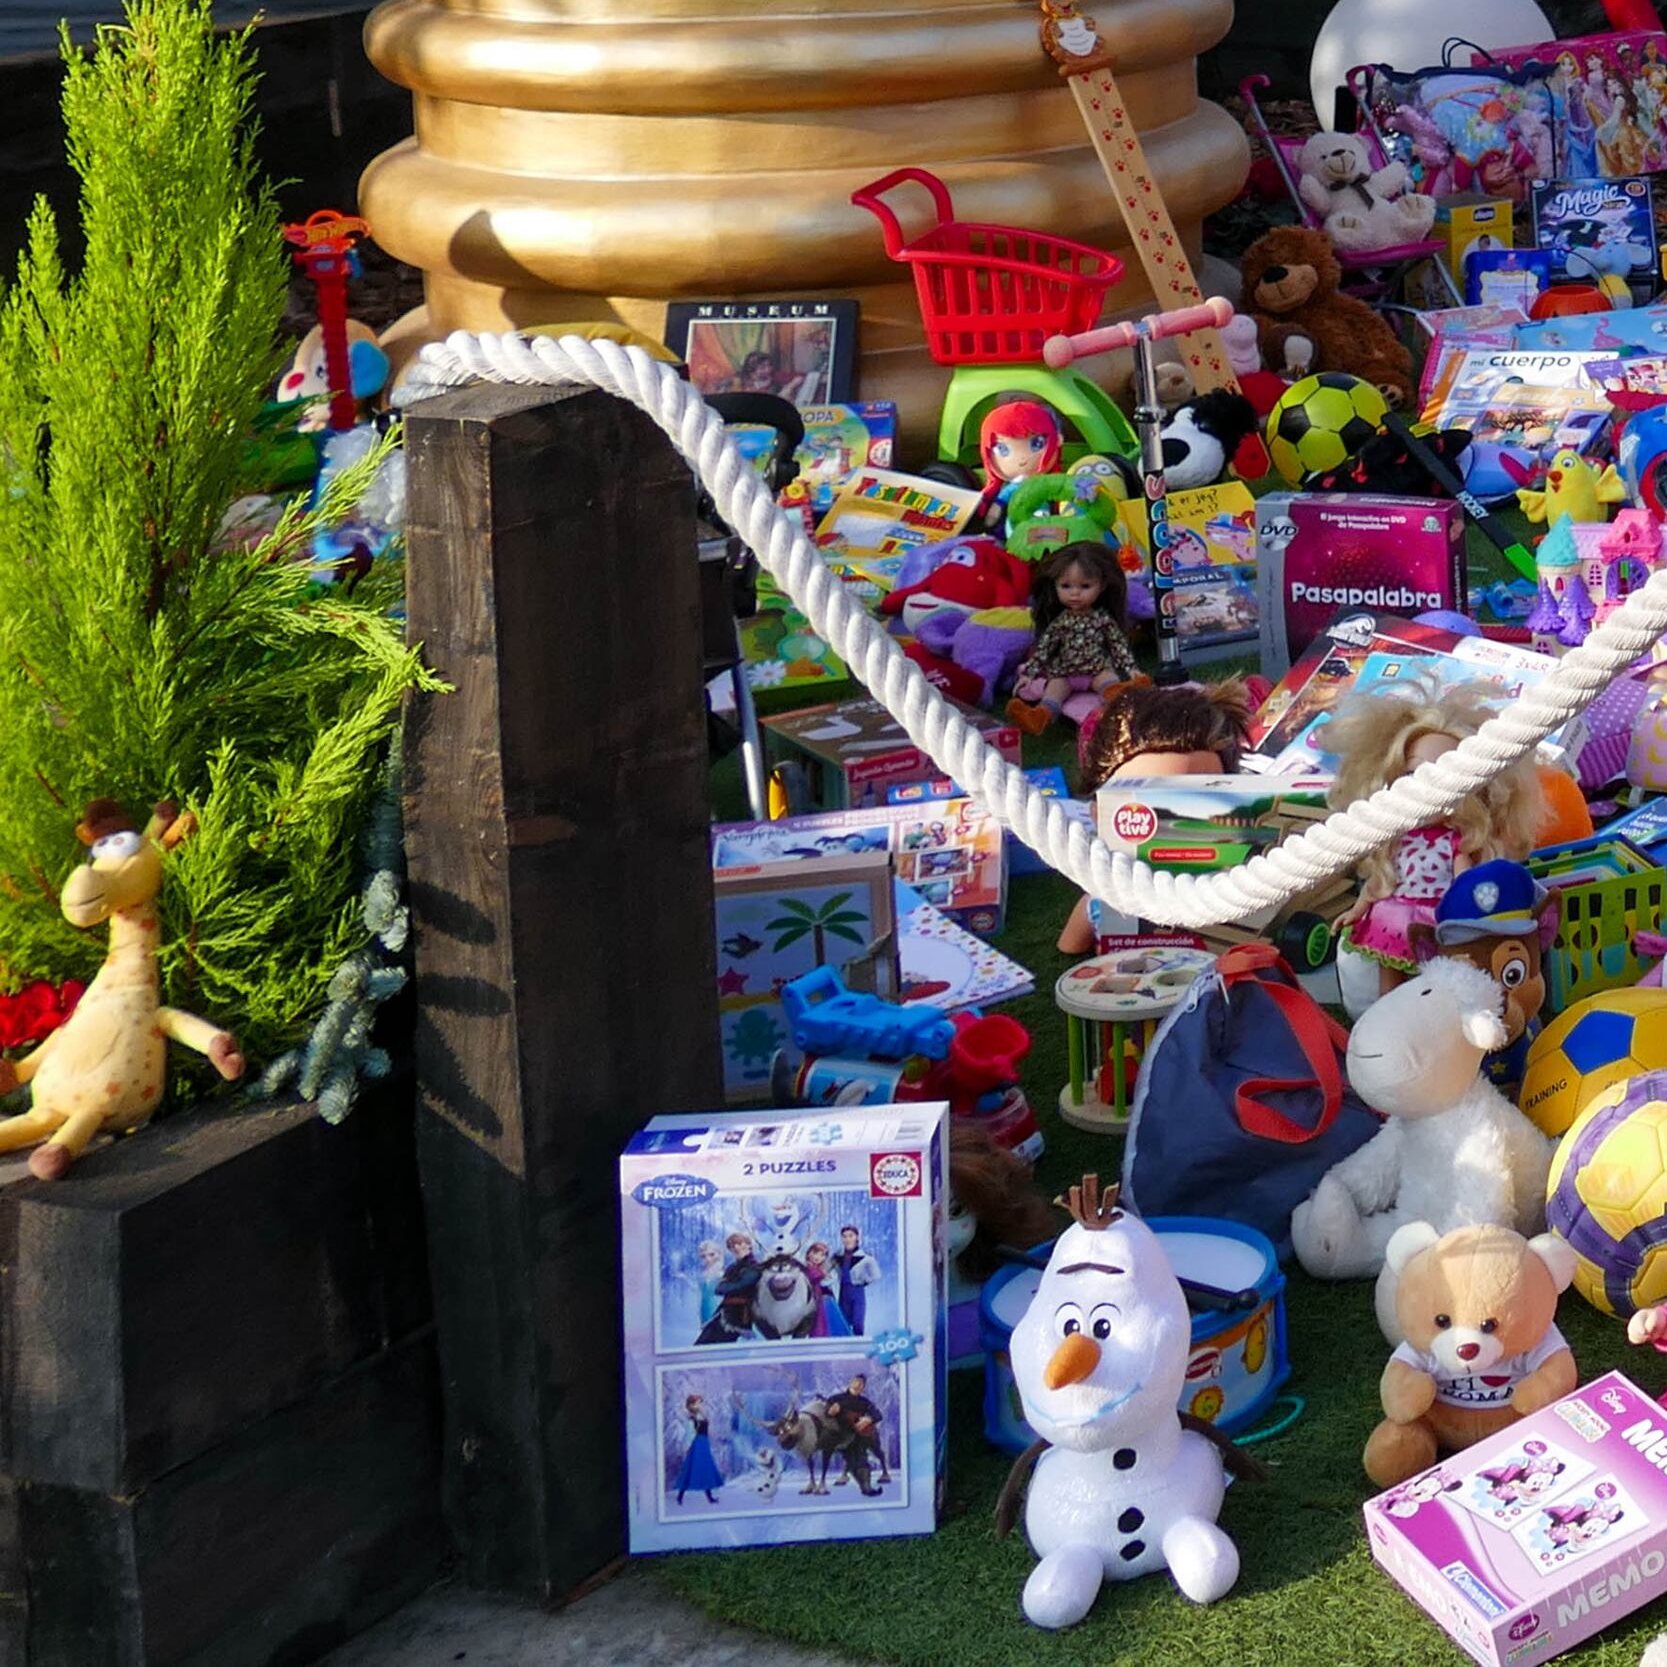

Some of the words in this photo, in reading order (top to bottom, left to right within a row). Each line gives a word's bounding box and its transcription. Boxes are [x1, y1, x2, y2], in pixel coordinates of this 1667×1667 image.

[1555, 185, 1620, 217] Magic
[698, 305, 829, 316] MUSEUM
[1470, 358, 1485, 367] mi
[1489, 353, 1572, 376] cuerpo
[1456, 491, 1490, 520] HOCKEY
[1260, 521, 1297, 536] DVD
[1291, 582, 1442, 609] Pasapalabra
[1116, 809, 1151, 825] Play
[1118, 820, 1151, 836] tive
[1108, 938, 1123, 946] Set
[1124, 937, 1136, 946] de
[1137, 936, 1195, 947] construcción
[1523, 1078, 1568, 1111] TRAINING
[743, 1163, 755, 1176] 2
[759, 1159, 838, 1175] PUZZLES
[881, 1168, 911, 1180] EDUCA
[642, 1183, 708, 1202] FROZEN
[877, 1336, 910, 1354] 100
[1600, 1389, 1627, 1416] Disney
[1453, 1569, 1507, 1618] Clementoni
[1556, 1549, 1667, 1629] MEMO
